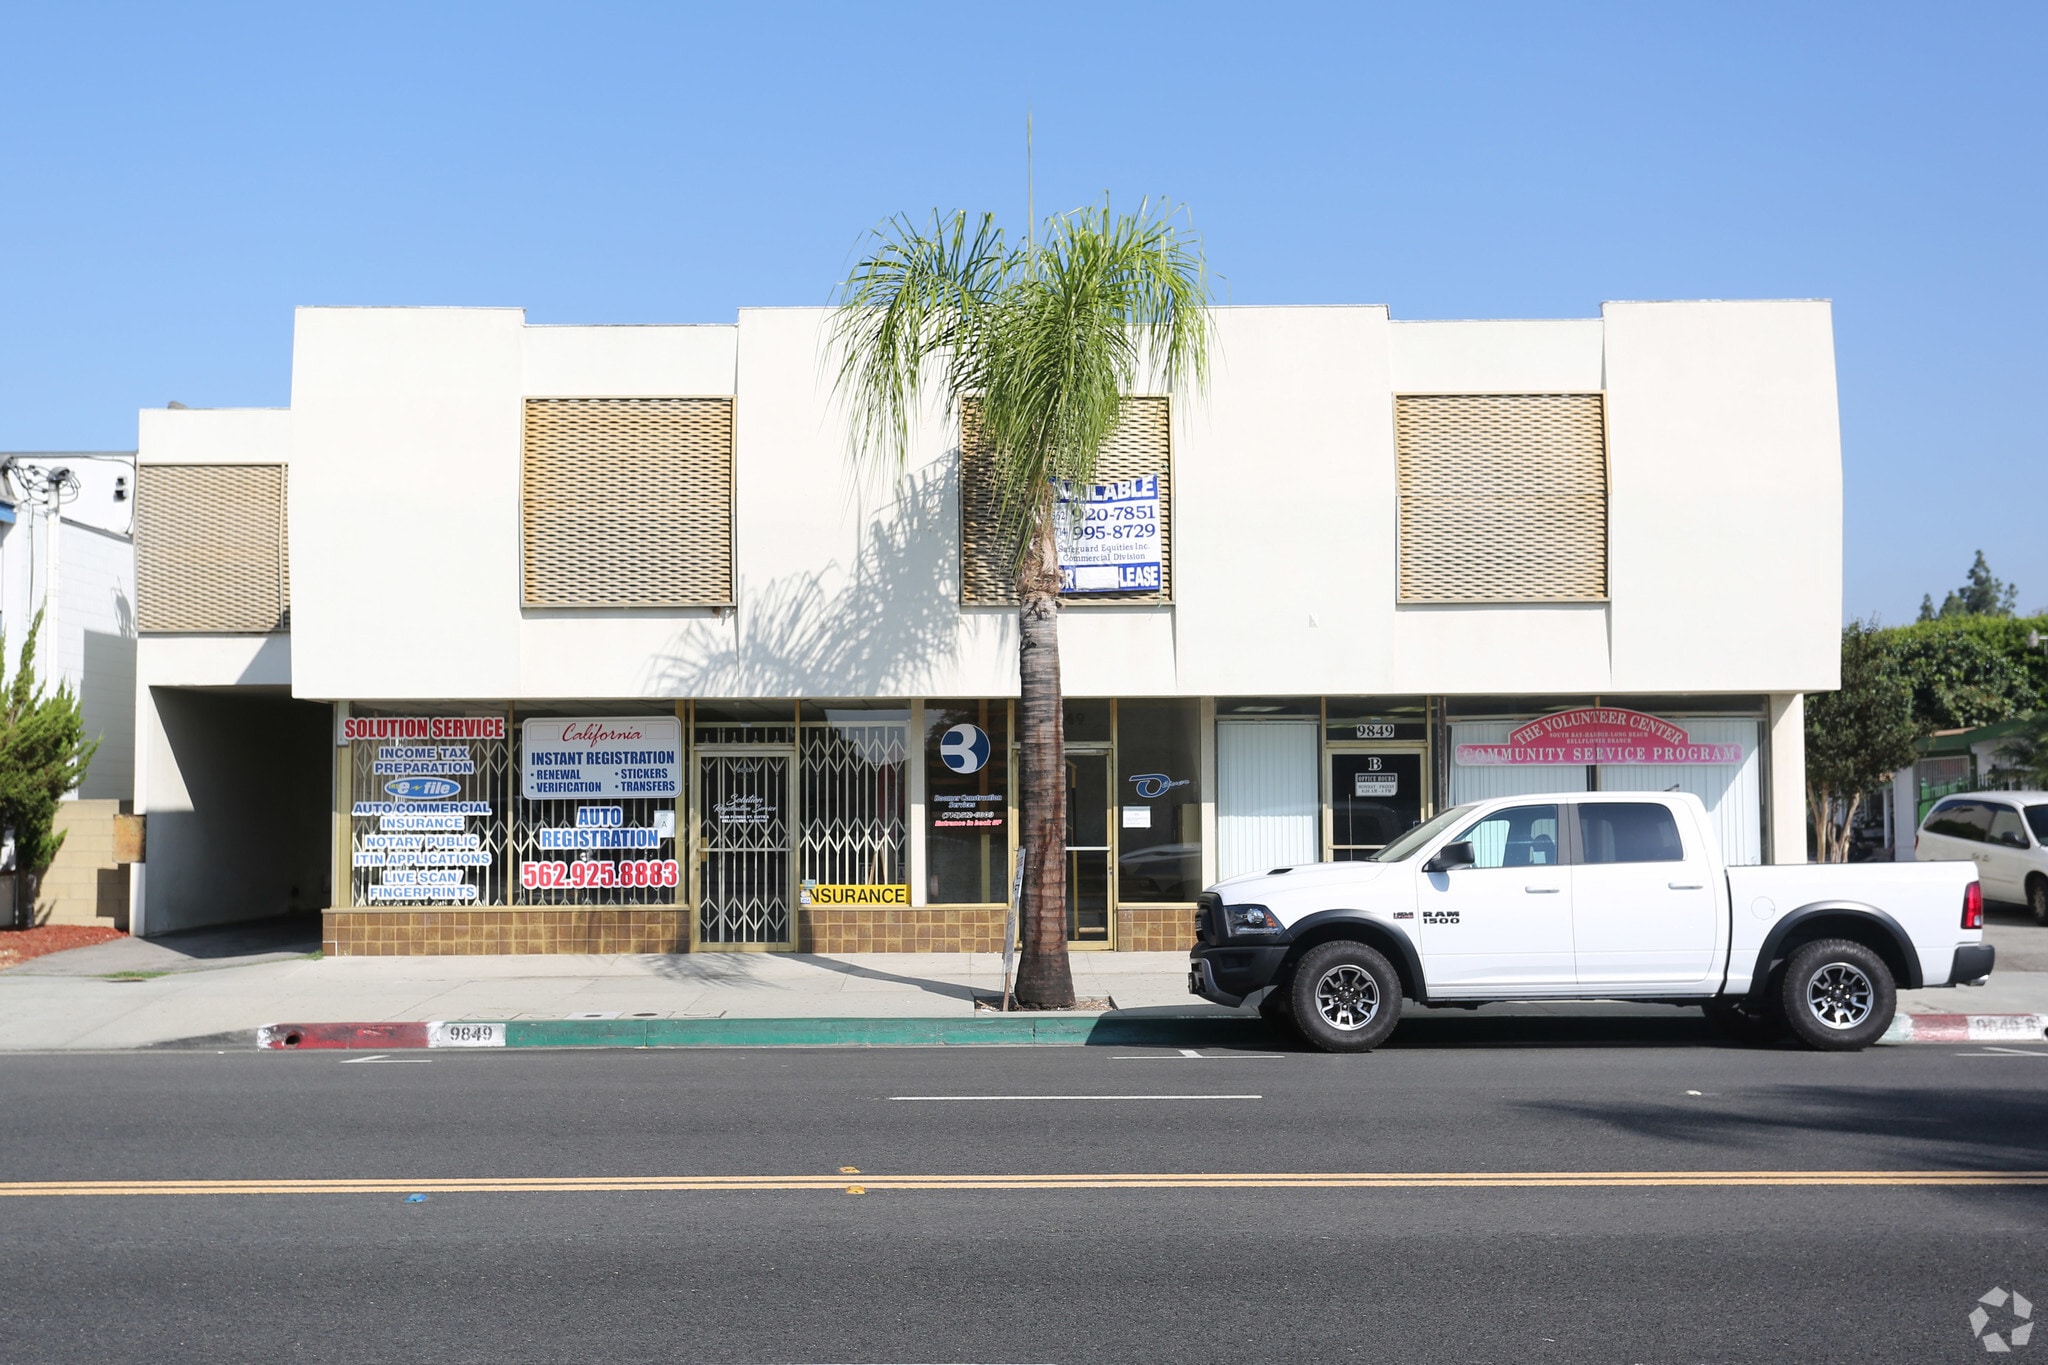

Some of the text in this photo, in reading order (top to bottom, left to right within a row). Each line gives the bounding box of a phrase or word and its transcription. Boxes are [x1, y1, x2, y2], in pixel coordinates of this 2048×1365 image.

[1073, 523, 1156, 540] 995-8729
[1058, 544, 1099, 554] Safeguard
[1101, 543, 1133, 553] Equities
[1063, 551, 1146, 562] Commercial Division
[1119, 566, 1159, 587] LEASE
[345, 719, 504, 738] SOLUTION SERVICE
[1357, 725, 1394, 737] 9849
[1514, 710, 1683, 745] THE VOLUNTEER CENTER
[562, 722, 642, 747] California
[380, 748, 468, 758] INCOME TAX
[532, 751, 675, 765] INSTANT REGISTRATION
[1464, 747, 1735, 761] COMMUNITY SERVICE PROGRAM
[375, 763, 473, 773] PREPARATION
[1368, 757, 1382, 771] B
[536, 770, 581, 780] RENEWAL
[621, 768, 668, 779] STICKERS
[536, 782, 602, 793] VERIFICATION
[621, 781, 675, 791] TRANSFERS
[726, 794, 763, 805] Solution
[354, 803, 491, 814] AUTO/COMMERCIAL
[578, 808, 622, 825] AUTO
[382, 818, 463, 828] INSURANCE
[366, 837, 478, 847] NOTARY PUBLIC
[542, 830, 659, 847] REGISTRATION
[355, 853, 490, 864] ITIN APPLICATIONS
[385, 873, 415, 882] LIVE
[523, 862, 678, 887] 562.925.8883
[370, 887, 475, 898] FINGERPRINTS
[810, 888, 906, 903] NSURANCE
[450, 1026, 493, 1041] 9849
